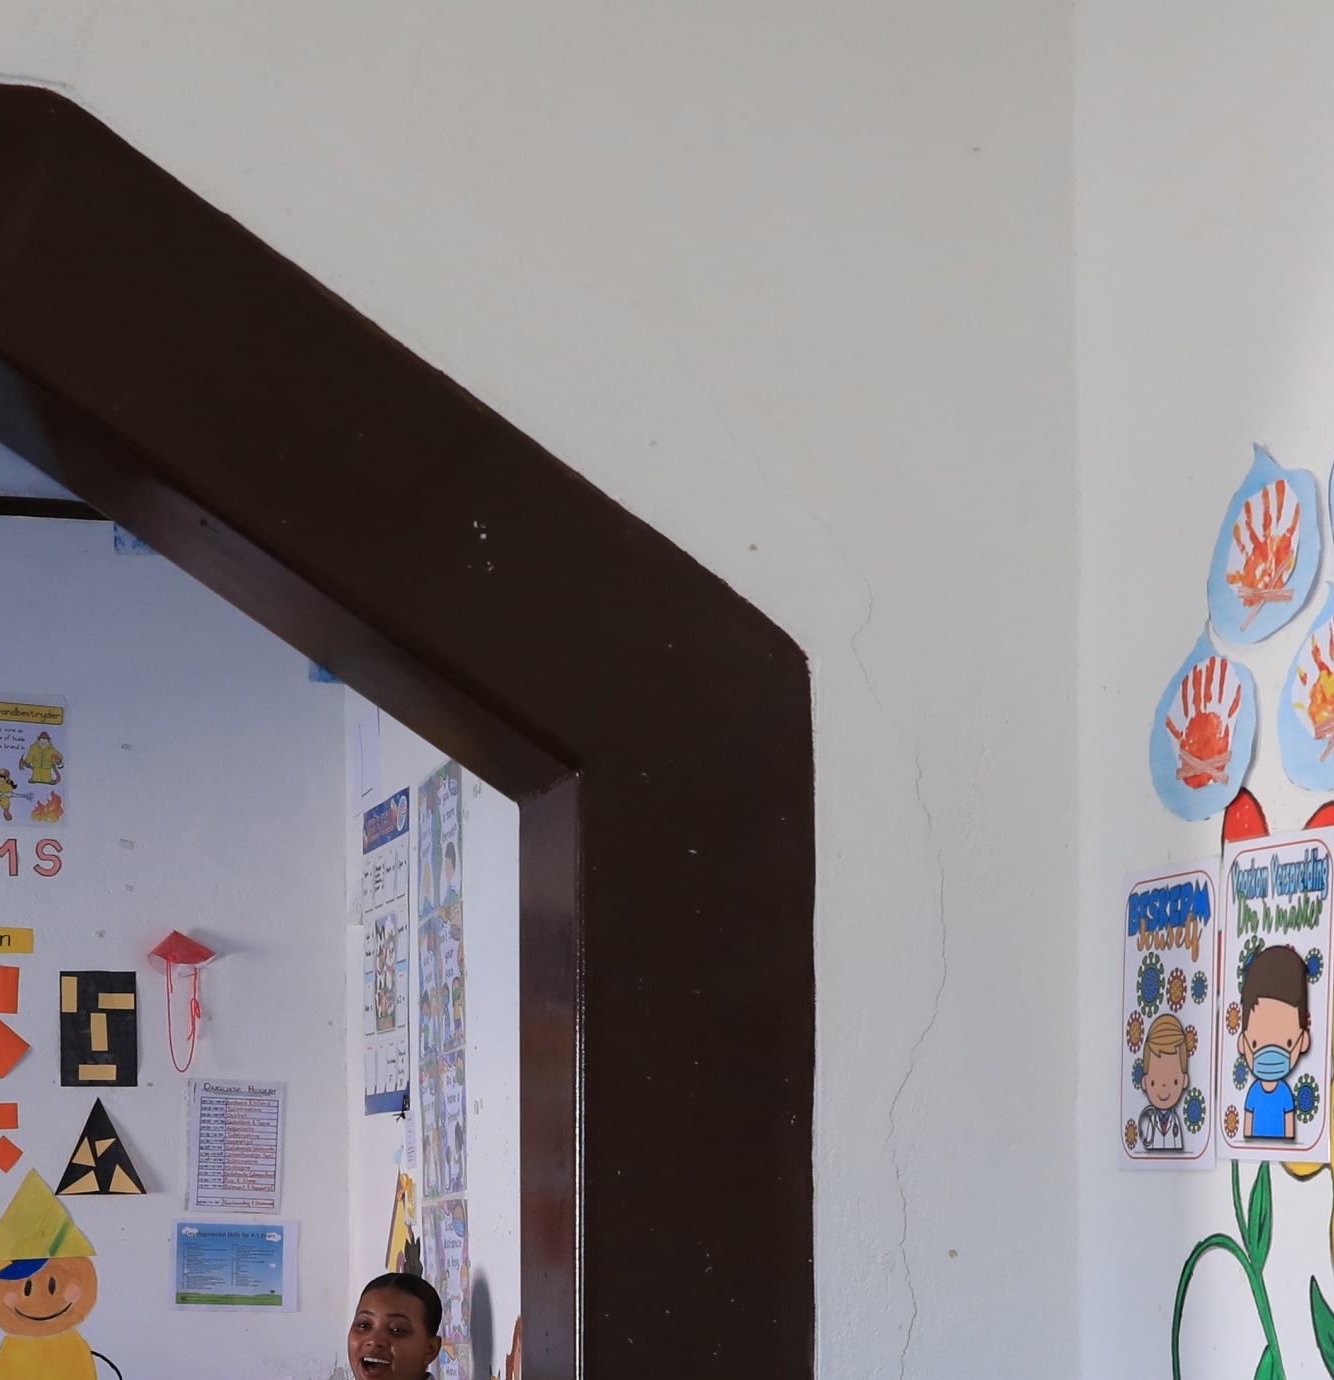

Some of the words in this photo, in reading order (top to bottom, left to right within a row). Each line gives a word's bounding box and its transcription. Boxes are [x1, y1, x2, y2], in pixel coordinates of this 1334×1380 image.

[1232, 858, 1268, 905] Voorkom
[1270, 847, 1329, 903] Verspreiding
[1128, 878, 1211, 936] BESKERM
[1237, 891, 1259, 938] Dra
[1275, 888, 1322, 935] masker
